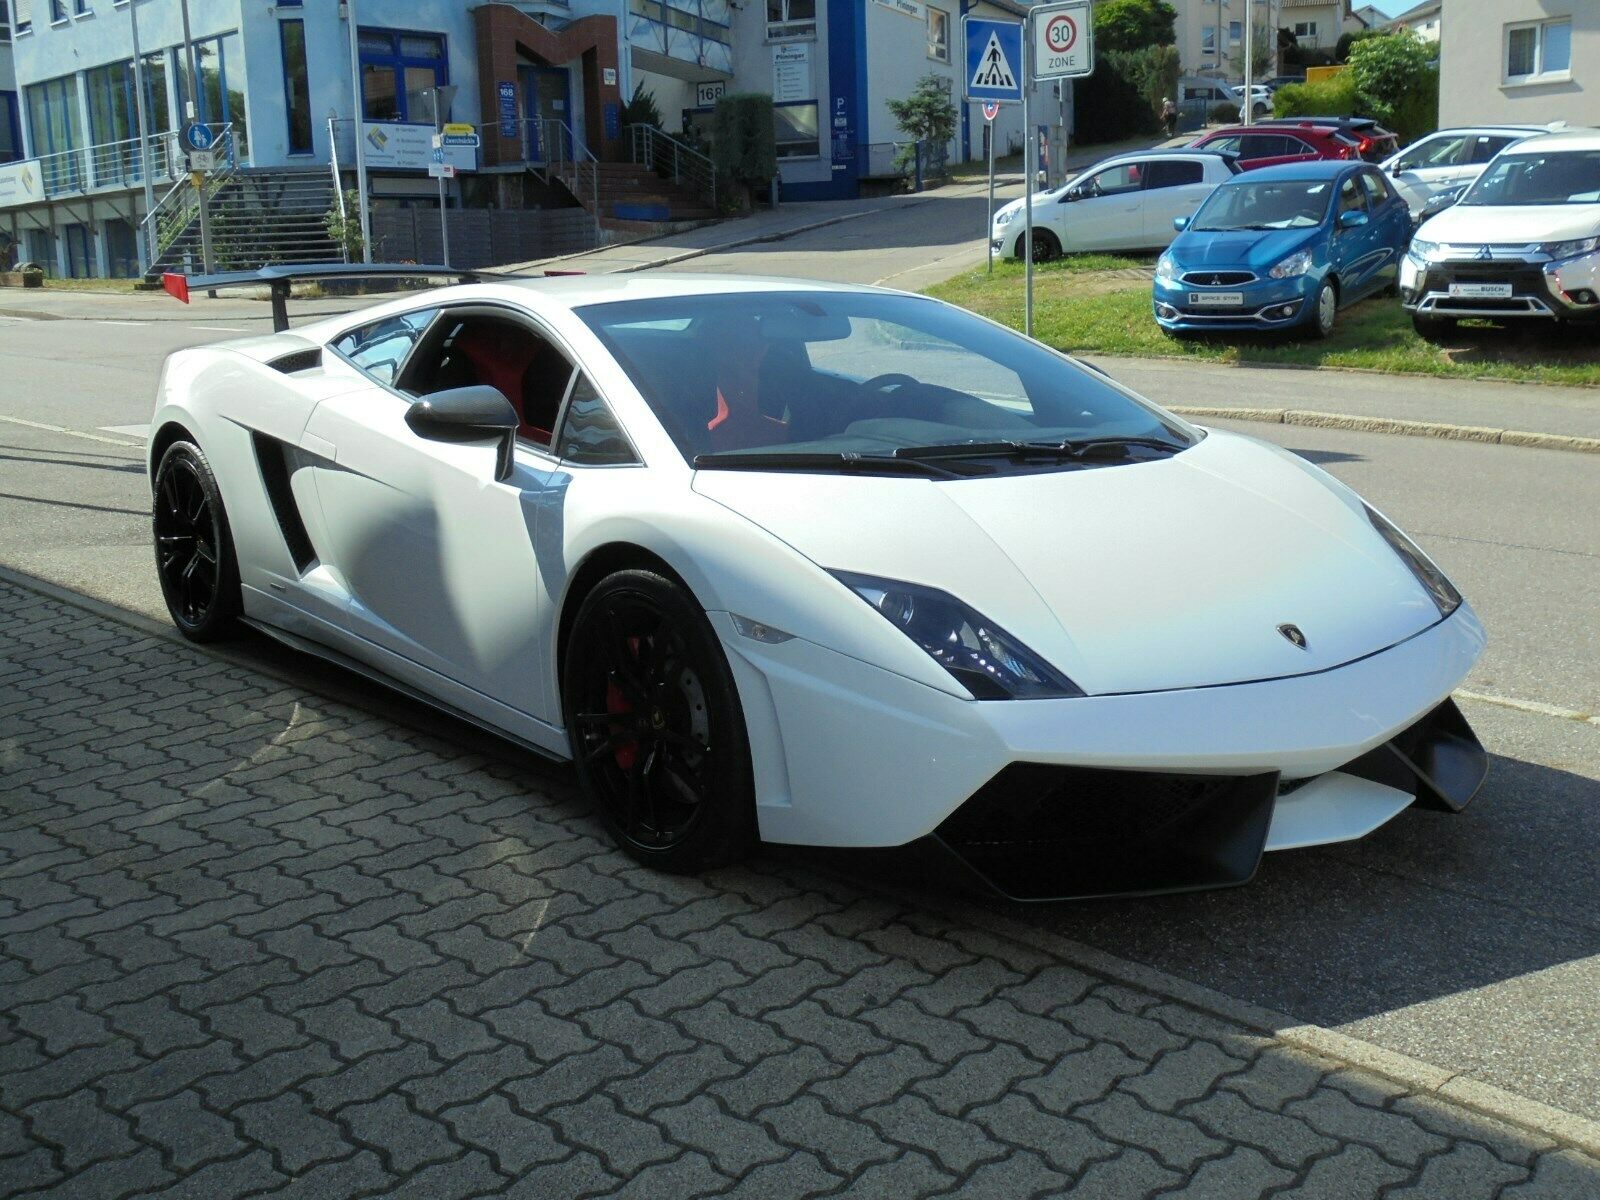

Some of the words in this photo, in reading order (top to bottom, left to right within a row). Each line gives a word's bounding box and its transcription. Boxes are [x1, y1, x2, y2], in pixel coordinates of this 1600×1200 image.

[1051, 25, 1070, 43] 30
[1048, 55, 1075, 69] ZONE
[500, 88, 514, 97] 168
[700, 87, 722, 101] 168
[837, 97, 845, 109] P
